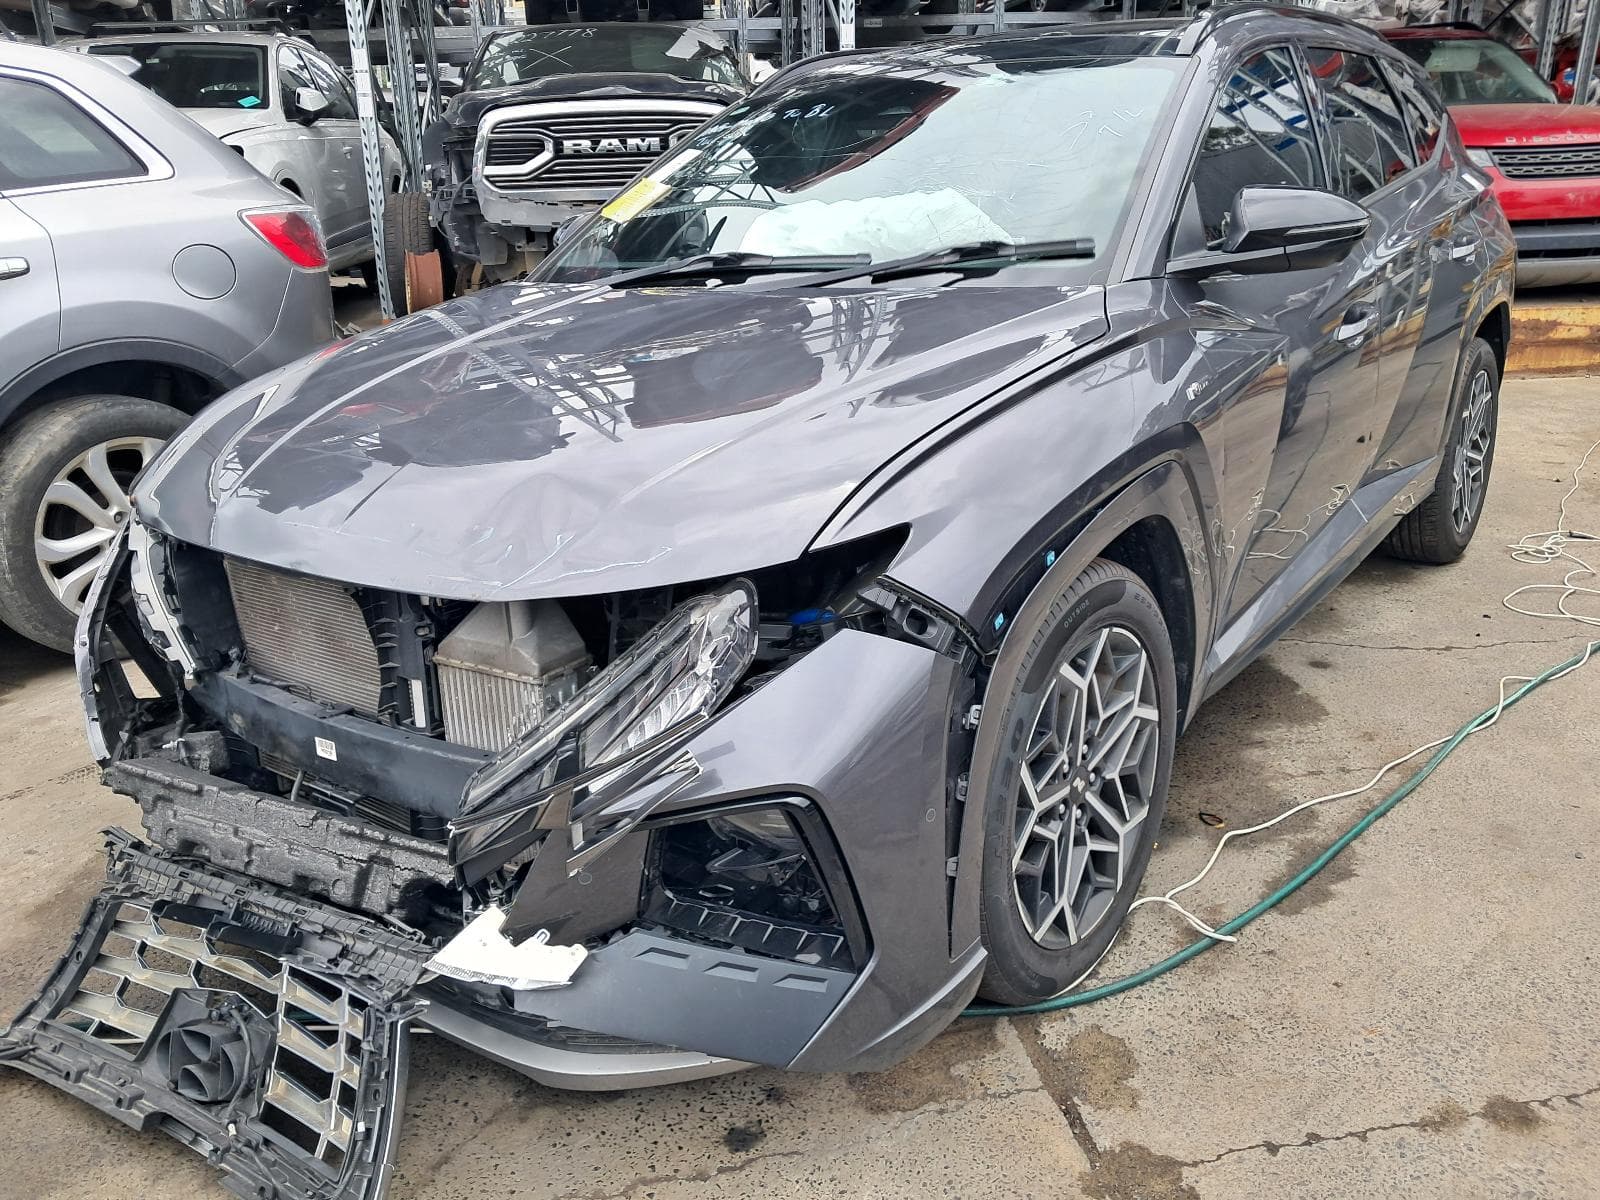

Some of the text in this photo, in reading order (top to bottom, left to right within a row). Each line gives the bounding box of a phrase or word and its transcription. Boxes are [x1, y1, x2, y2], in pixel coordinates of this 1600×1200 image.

[562, 136, 661, 155] RAM
[1505, 133, 1600, 144] DISCOV
[1063, 598, 1091, 629] OUTSIDE
